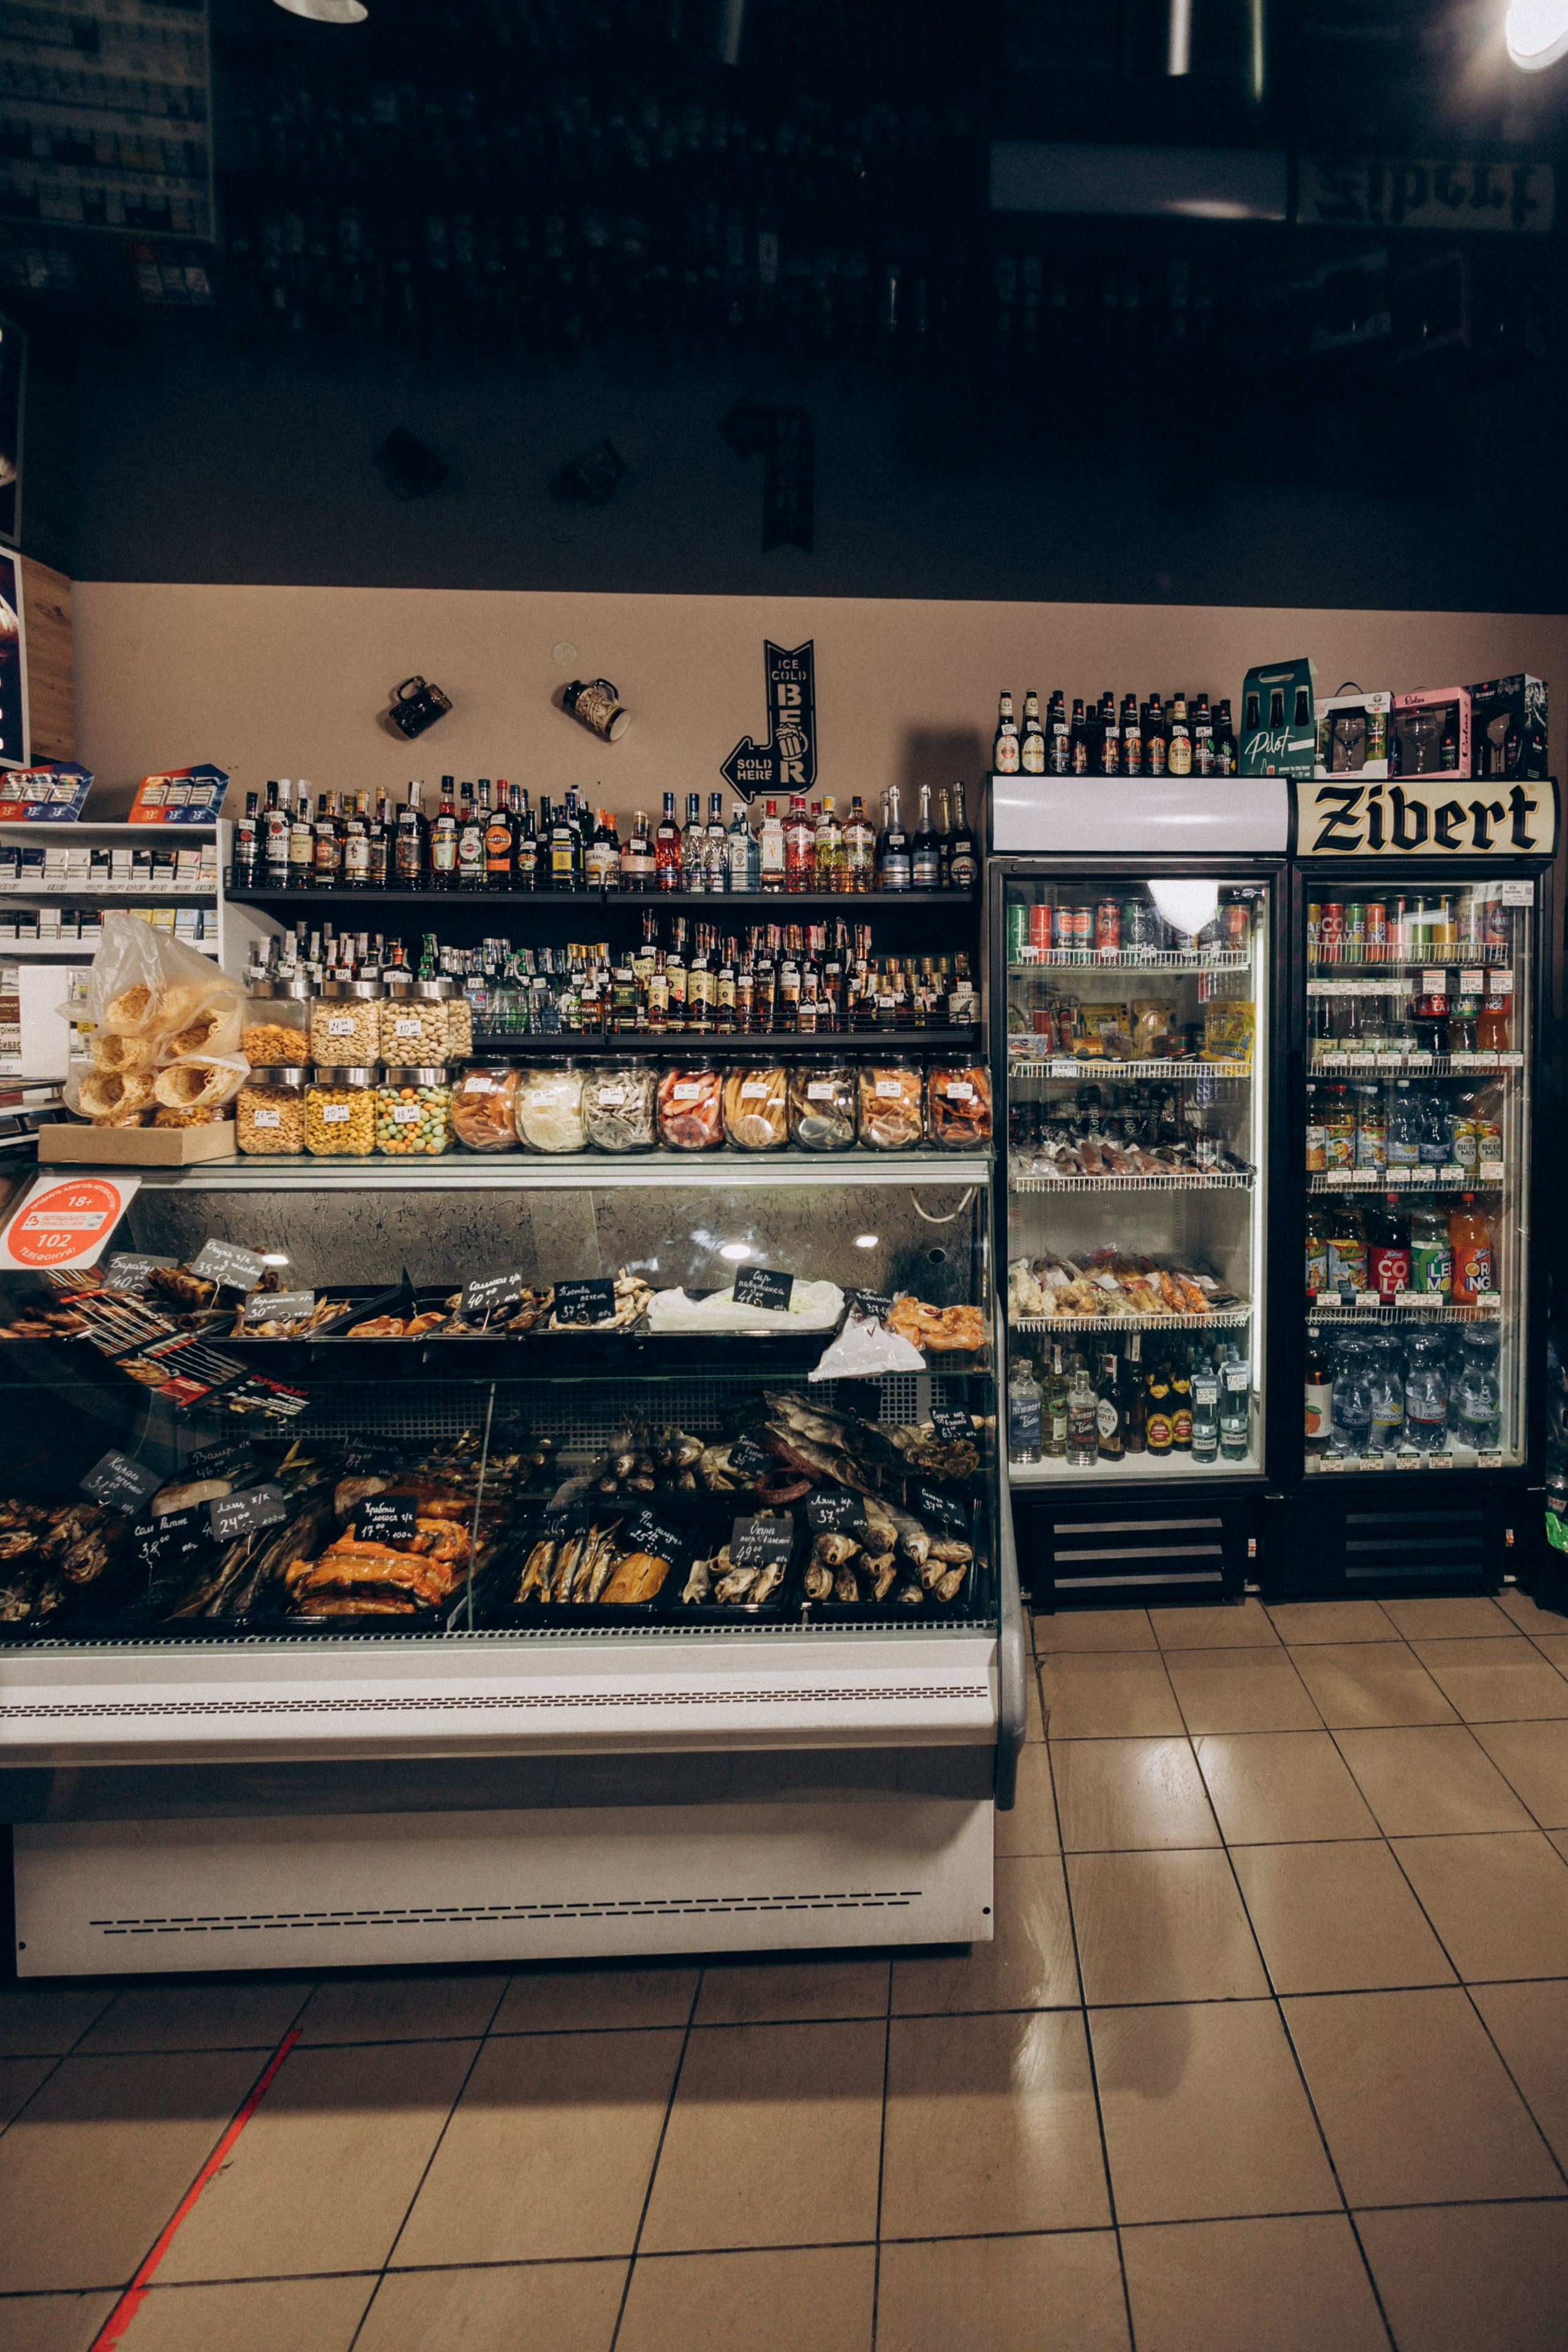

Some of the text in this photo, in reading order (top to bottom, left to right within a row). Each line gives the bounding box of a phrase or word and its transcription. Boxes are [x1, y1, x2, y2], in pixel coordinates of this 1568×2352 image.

[778, 659, 799, 669] ICE
[772, 671, 807, 680] COLD
[1245, 726, 1295, 764] Pilot
[737, 760, 772, 769] SOLD
[737, 770, 772, 780] HERE
[1312, 783, 1540, 852] Zibert
[0, 1025, 20, 1035] ріння
[31, 1189, 62, 1210] ПРОДАЮТЬ
[68, 1196, 94, 1207] 18+
[37, 1234, 72, 1247] 102
[20, 1247, 76, 1261] ТЕЛЕФОНУЙ!
[1379, 1260, 1407, 1278] CO
[752, 1270, 772, 1282] Сир
[1383, 1278, 1405, 1294] LA
[1012, 1402, 1041, 1415] NEMIROFF
[1069, 1411, 1095, 1420] NEMIROFF
[811, 1494, 836, 1506] Лящ
[219, 1517, 238, 1534] 24
[750, 1520, 775, 1536] Окунь
[736, 1548, 752, 1562] 49
